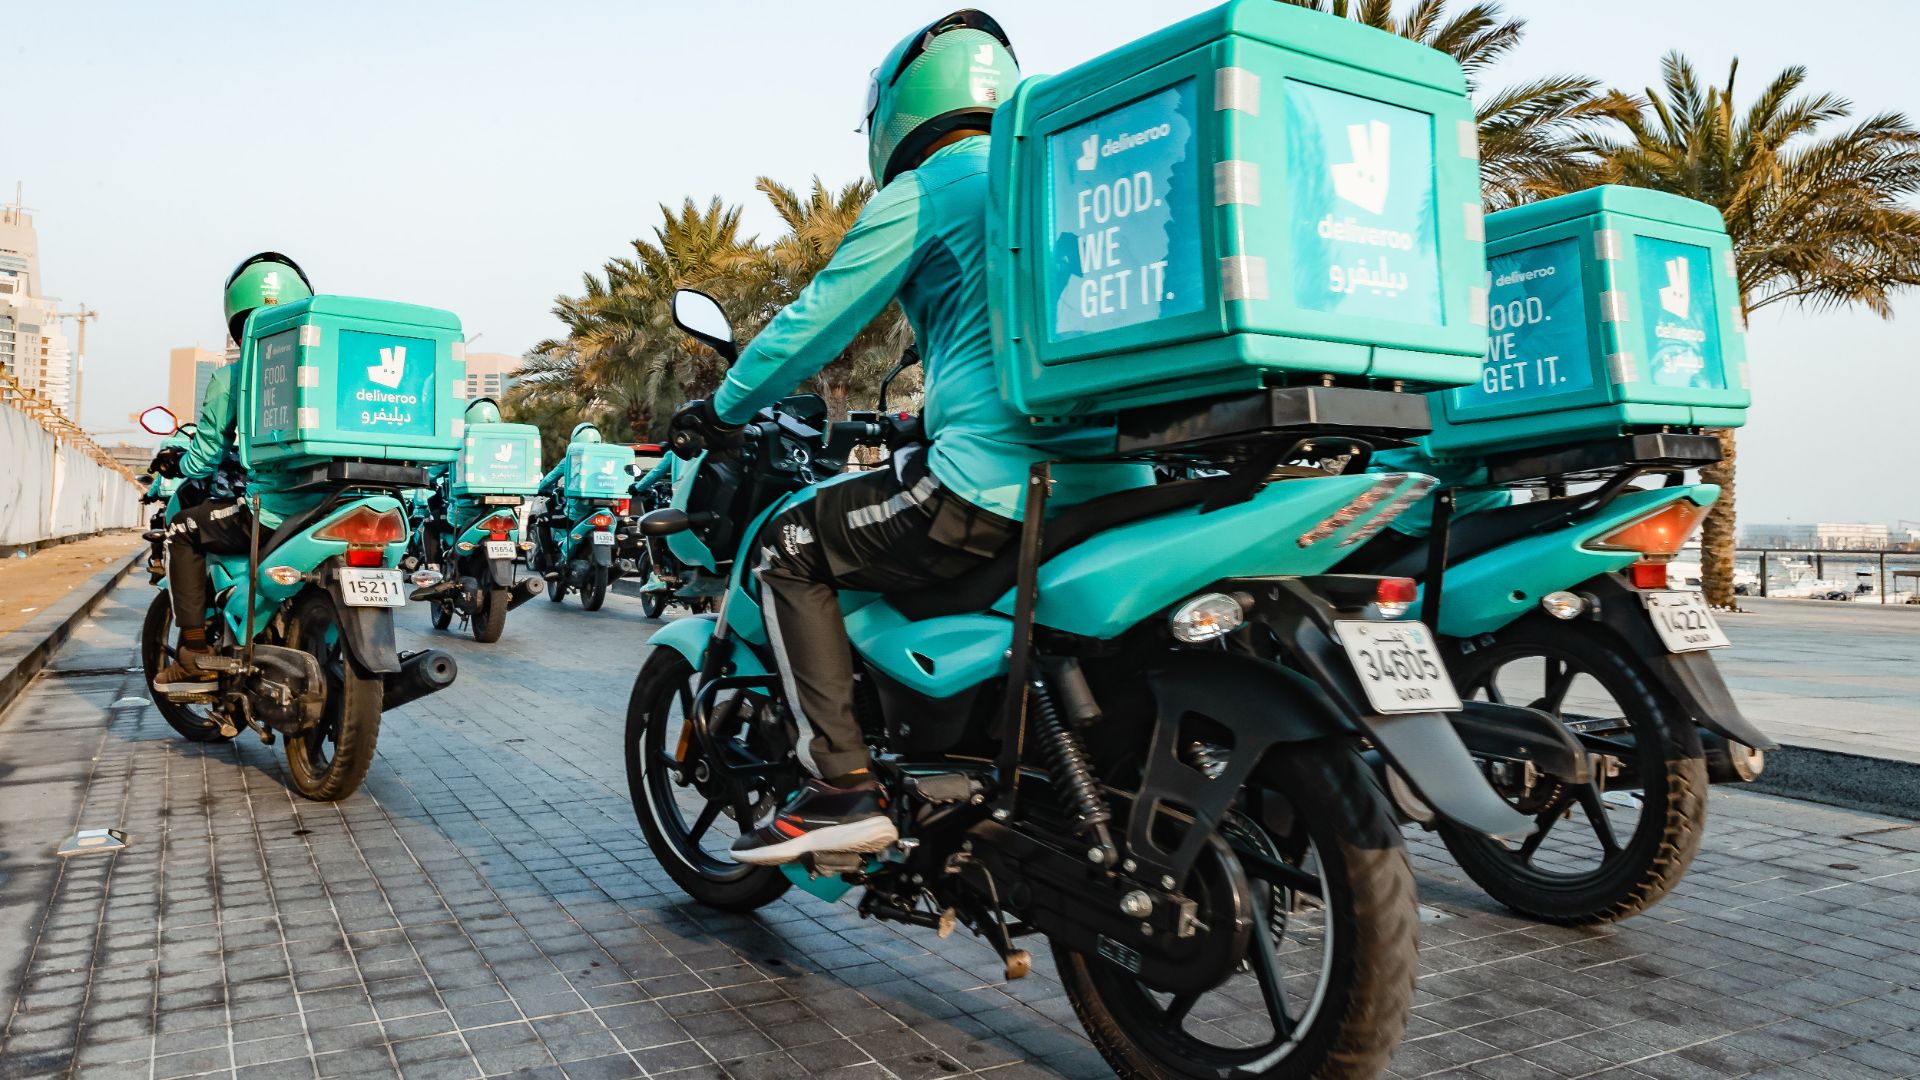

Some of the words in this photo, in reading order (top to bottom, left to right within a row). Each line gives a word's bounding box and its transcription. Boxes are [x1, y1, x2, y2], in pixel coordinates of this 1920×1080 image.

[1101, 123, 1171, 158] deliveroo
[1078, 171, 1161, 229] FOOD.
[1317, 215, 1413, 252] deliveroo
[1078, 227, 1122, 274] WE
[1080, 271, 1131, 319] GET
[1140, 260, 1176, 304] IT.
[1495, 266, 1556, 287] deliveroo
[1487, 296, 1552, 331] OOD.
[264, 365, 288, 386] FOOD.
[1482, 361, 1529, 394] GET
[1536, 356, 1567, 386] IT.
[263, 387, 277, 408] WE
[356, 388, 417, 405] deliveroo
[361, 407, 412, 425] ديليفرو
[349, 580, 398, 595] 15211
[1358, 649, 1440, 681] 34605
[1397, 688, 1432, 701] QATAR
